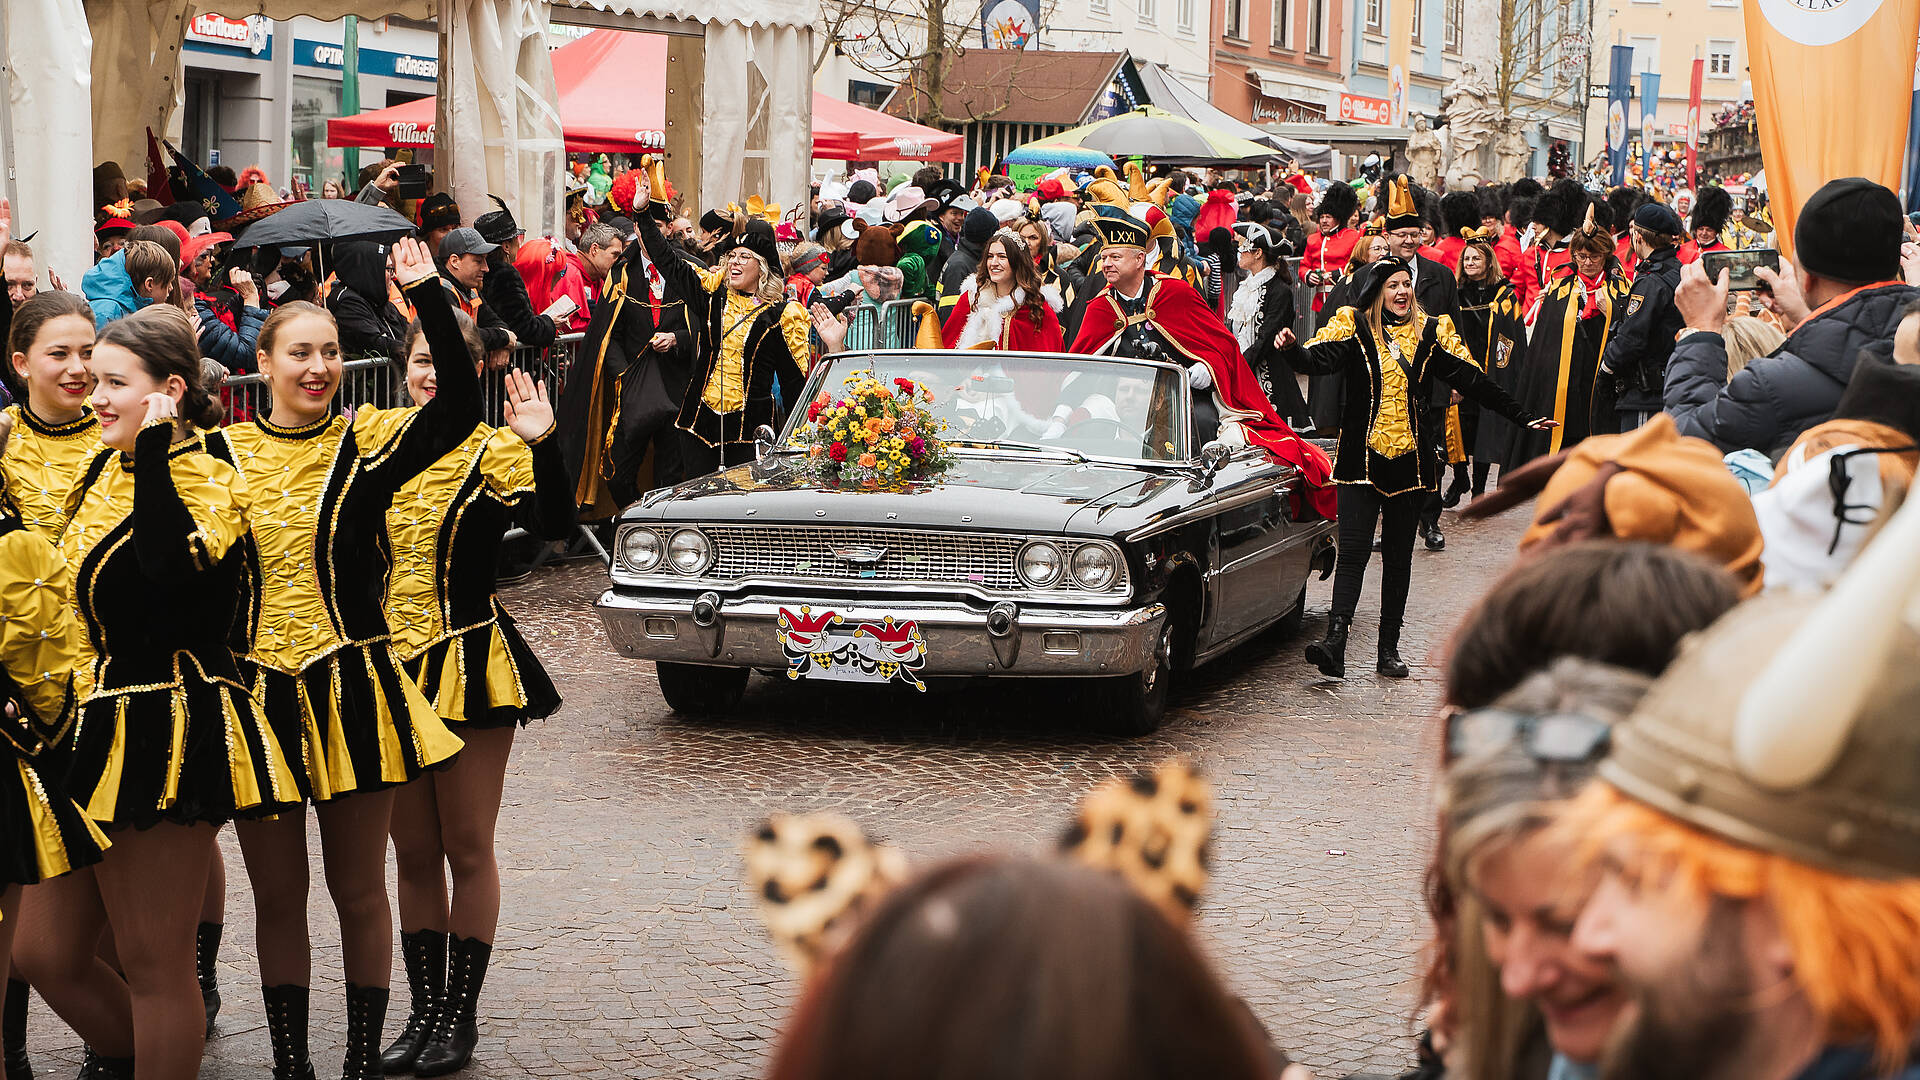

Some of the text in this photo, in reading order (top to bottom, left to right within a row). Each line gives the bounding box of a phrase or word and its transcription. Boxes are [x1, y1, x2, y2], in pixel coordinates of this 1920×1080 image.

[389, 122, 436, 144] Villach
[1110, 230, 1136, 243] LXXI
[746, 508, 972, 522] FORD
